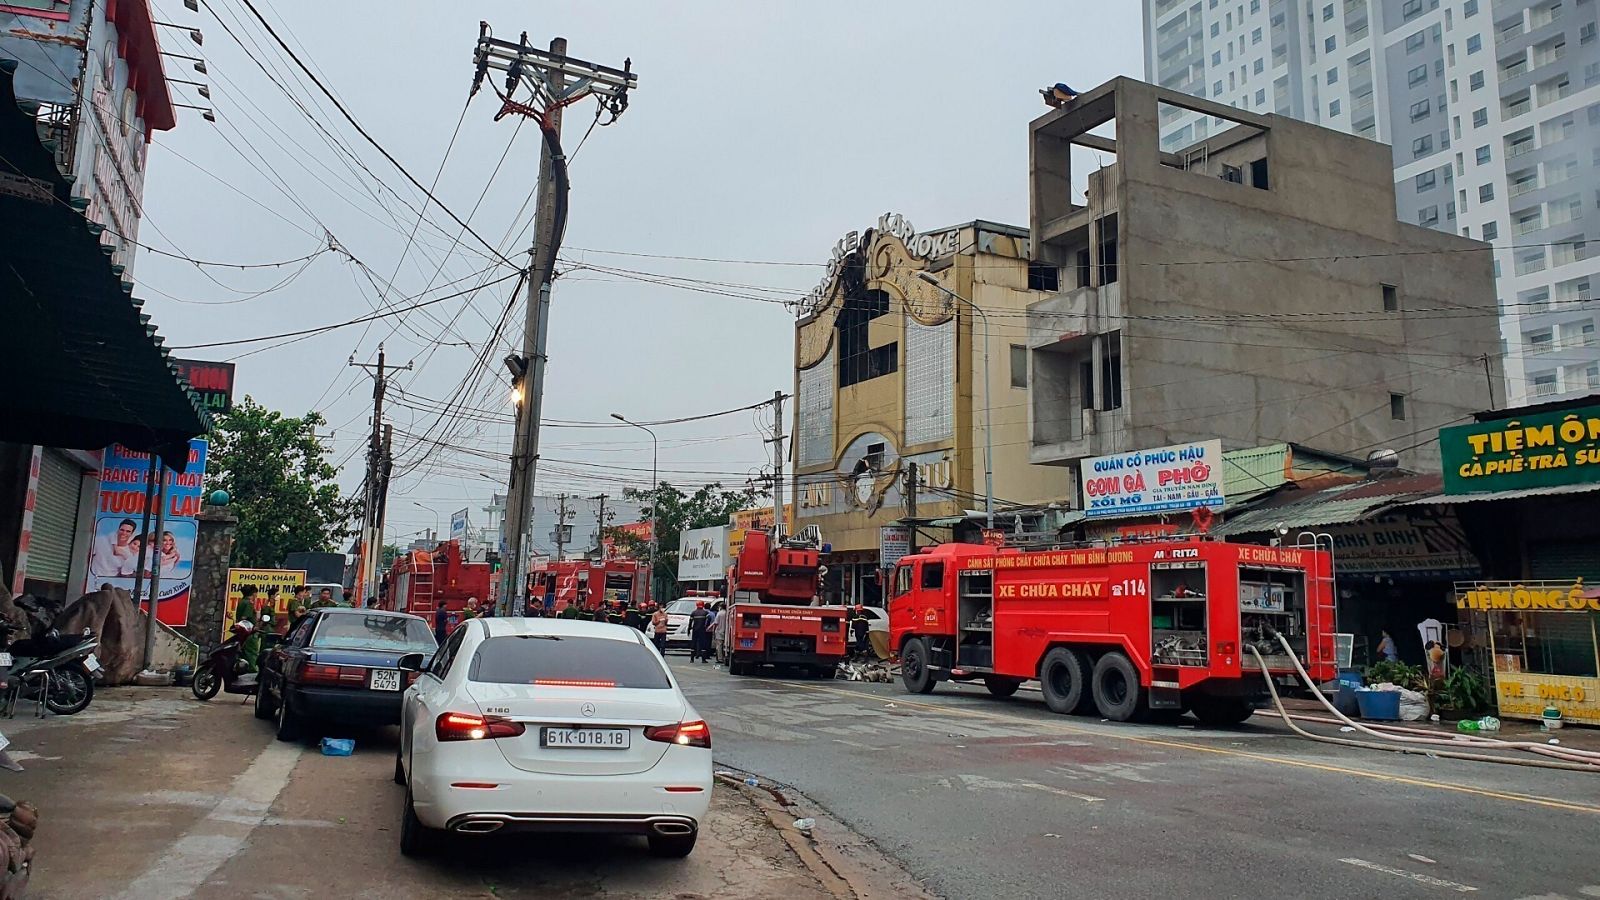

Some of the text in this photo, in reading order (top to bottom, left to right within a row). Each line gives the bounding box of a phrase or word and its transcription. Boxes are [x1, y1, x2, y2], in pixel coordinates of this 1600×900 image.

[878, 212, 959, 261] KARAOKE
[1468, 421, 1555, 456] TIỆM
[1094, 457, 1123, 472] QUÁN
[1145, 450, 1175, 466] PHÚC
[1179, 446, 1204, 462] HẬU
[1459, 456, 1483, 477] CÀ
[1086, 460, 1211, 497] CƠM GÀ PHỞ
[170, 496, 201, 517] LAI
[802, 484, 832, 509] AN
[983, 556, 994, 568] SÁT
[996, 556, 1015, 567] PHÒNG
[1016, 554, 1031, 567] CHÁY
[1033, 553, 1050, 566] CHỮA
[1051, 552, 1068, 566] CHÁY
[1088, 550, 1106, 564] BÌNH
[1238, 547, 1302, 564] XE CHỮA CHÁY
[999, 580, 1101, 597] XE CHỮA CHÁY
[1122, 579, 1146, 596] 114
[1512, 584, 1566, 610] ÔNG
[374, 680, 397, 690] 5479
[548, 731, 623, 745] 61K-018.18
